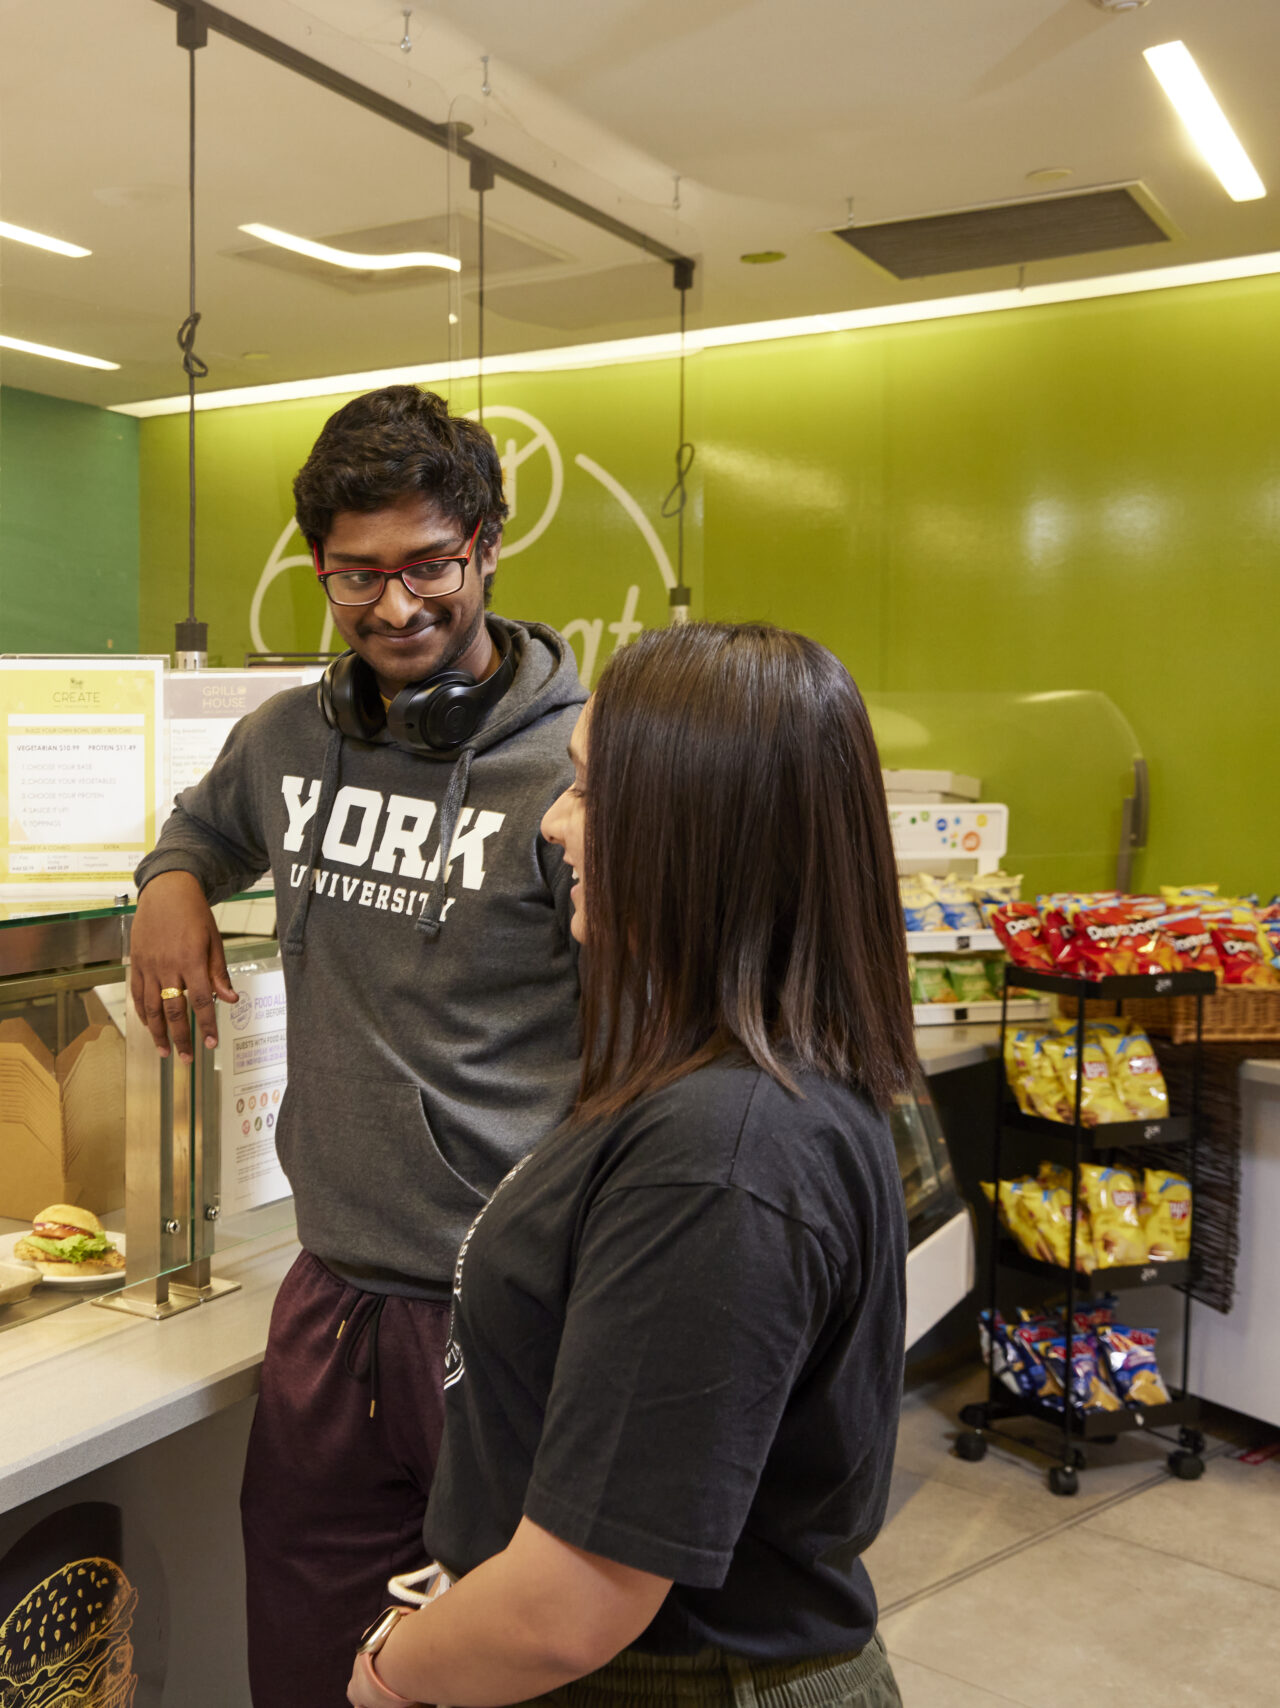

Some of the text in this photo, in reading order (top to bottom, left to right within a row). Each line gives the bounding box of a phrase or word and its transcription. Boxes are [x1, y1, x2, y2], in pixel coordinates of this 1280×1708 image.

[52, 691, 101, 703] CREATE
[202, 685, 236, 697] GRILL
[202, 697, 247, 709] HOUSE
[17, 744, 58, 752] VEGETARIAN
[60, 744, 80, 752] $10.99
[88, 744, 115, 752] PROTEIN
[281, 775, 506, 890] YORK
[254, 996, 273, 1009] FOOD
[266, 1006, 287, 1019] BEFORE
